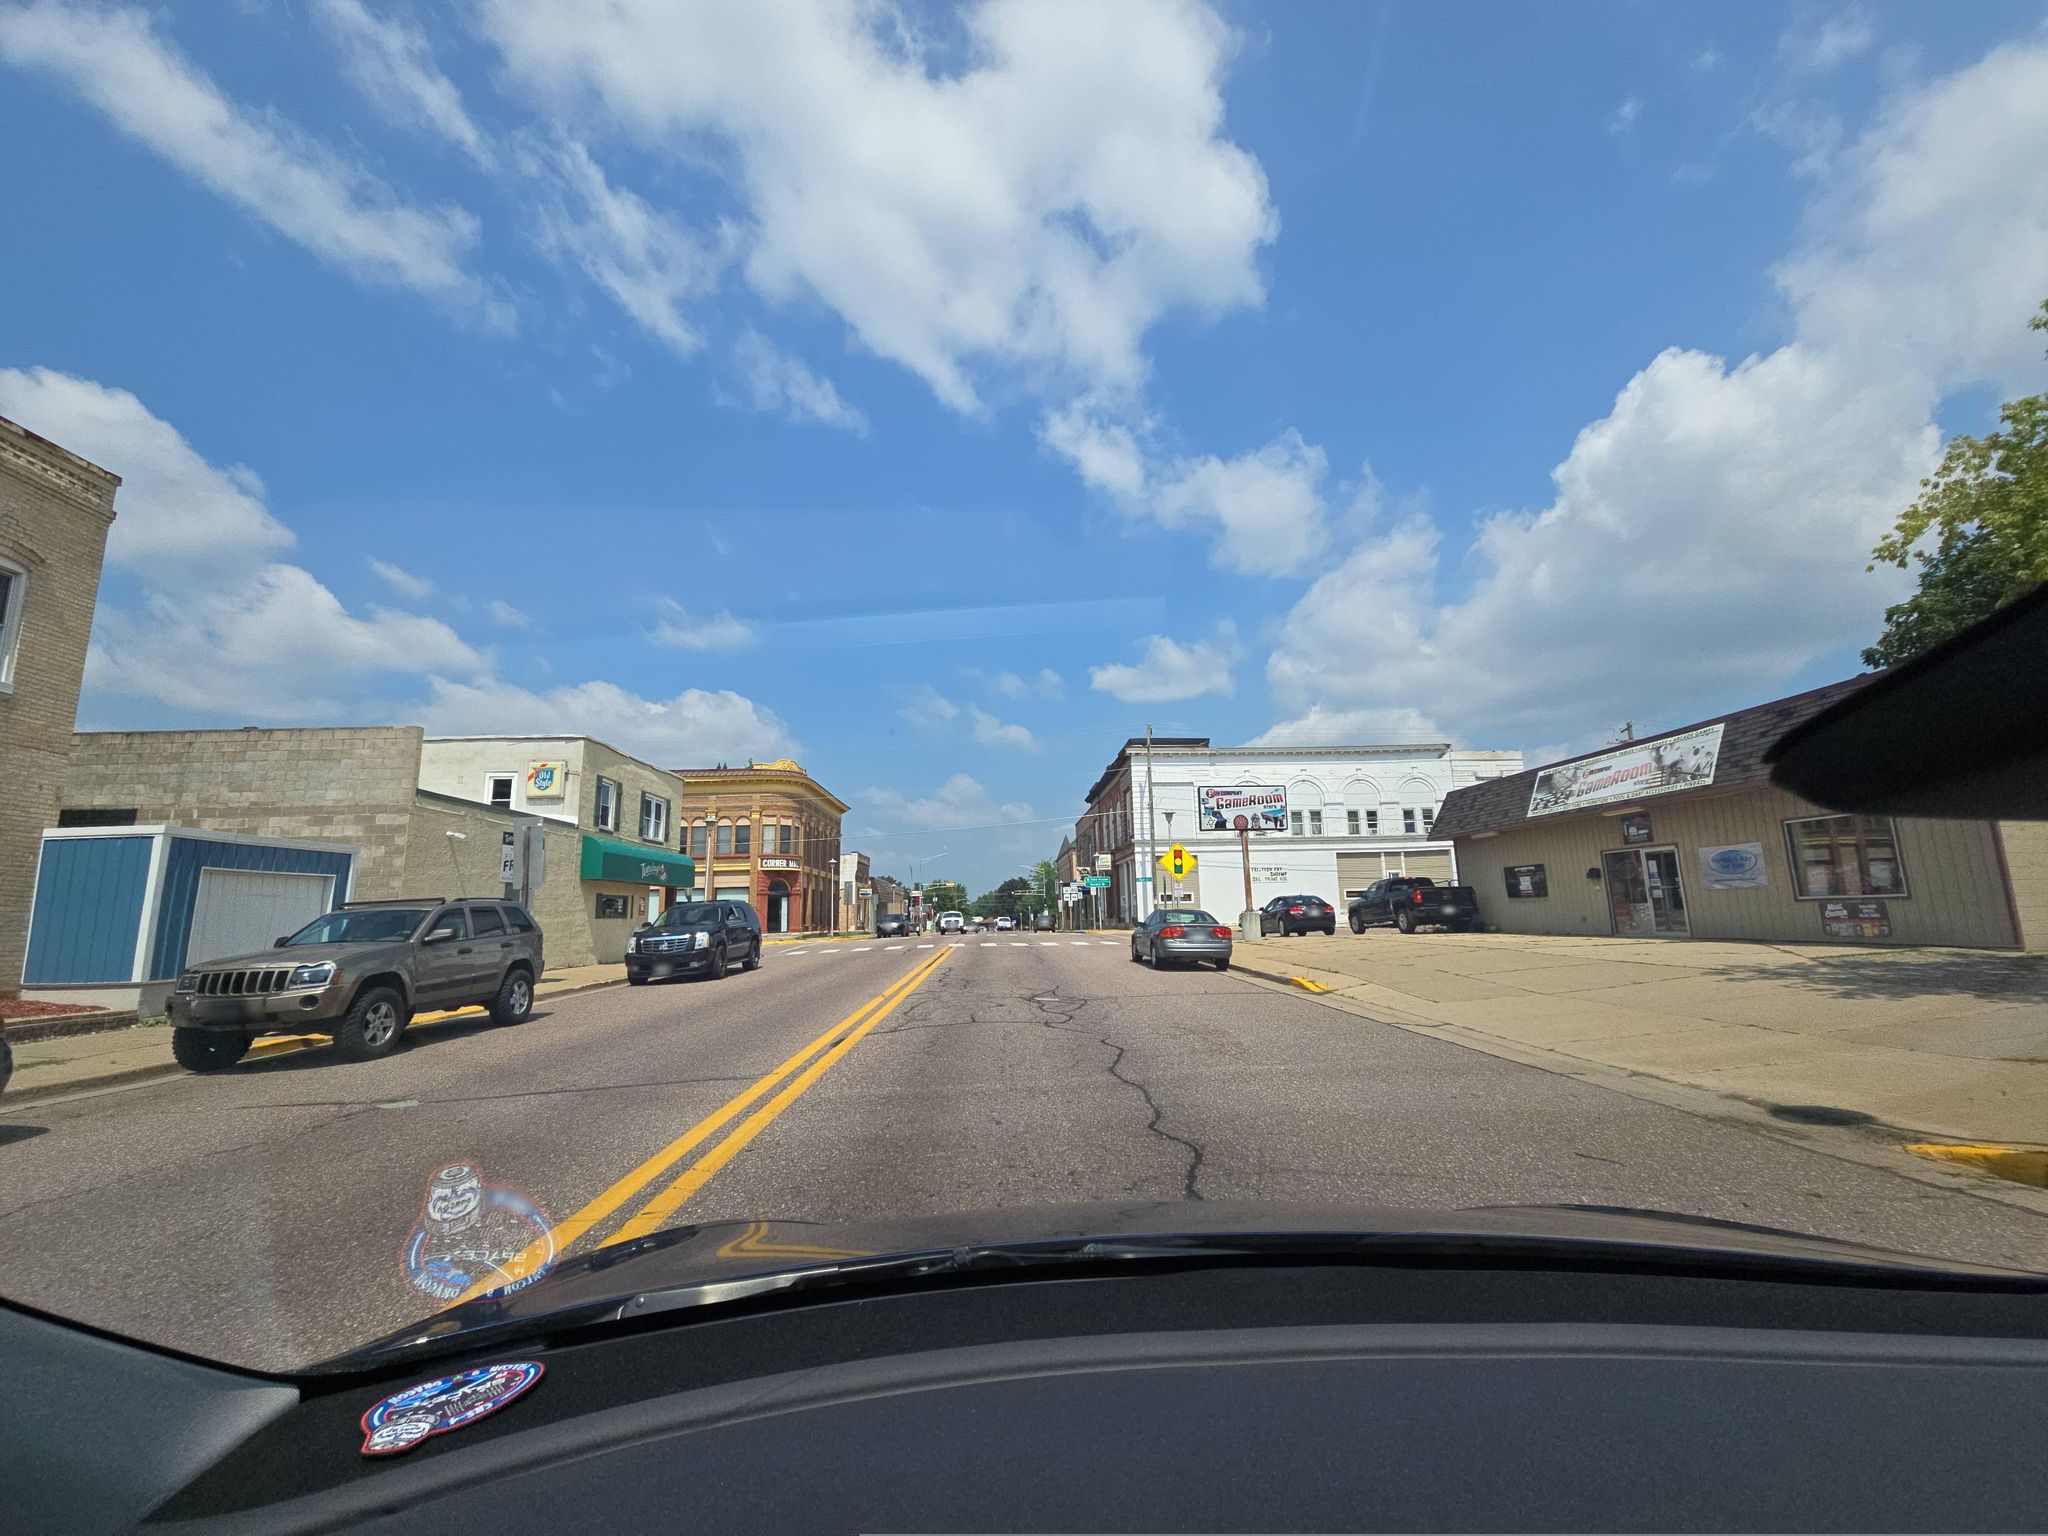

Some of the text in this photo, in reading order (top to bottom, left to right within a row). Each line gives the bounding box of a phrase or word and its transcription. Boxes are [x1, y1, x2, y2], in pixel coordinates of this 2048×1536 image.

[539, 771, 551, 779] Old
[535, 779, 552, 790] Style
[762, 859, 787, 868] CORNER
